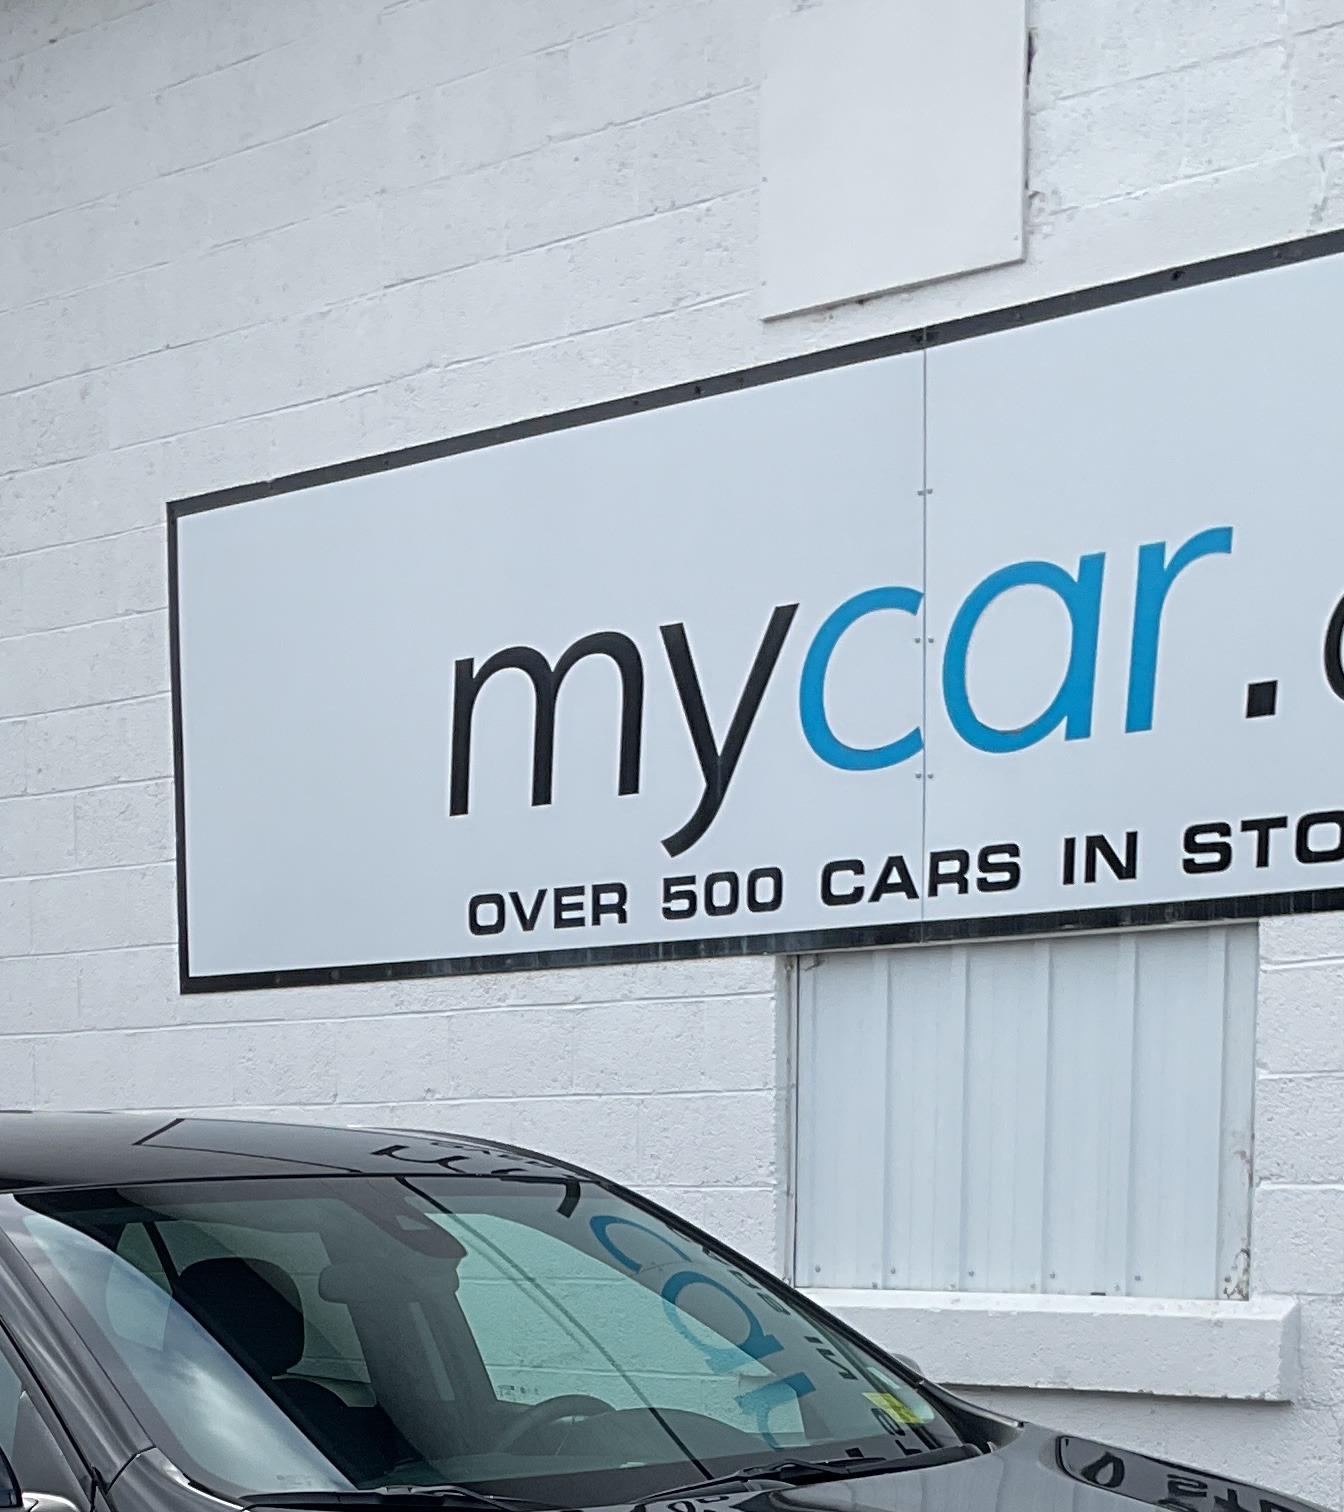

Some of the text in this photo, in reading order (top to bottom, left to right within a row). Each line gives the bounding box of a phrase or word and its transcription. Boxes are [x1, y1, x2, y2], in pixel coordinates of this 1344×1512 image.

[468, 881, 628, 936] OVER
[661, 866, 783, 920] 500
[821, 843, 1021, 907] CARS
[1062, 830, 1139, 886] IN
